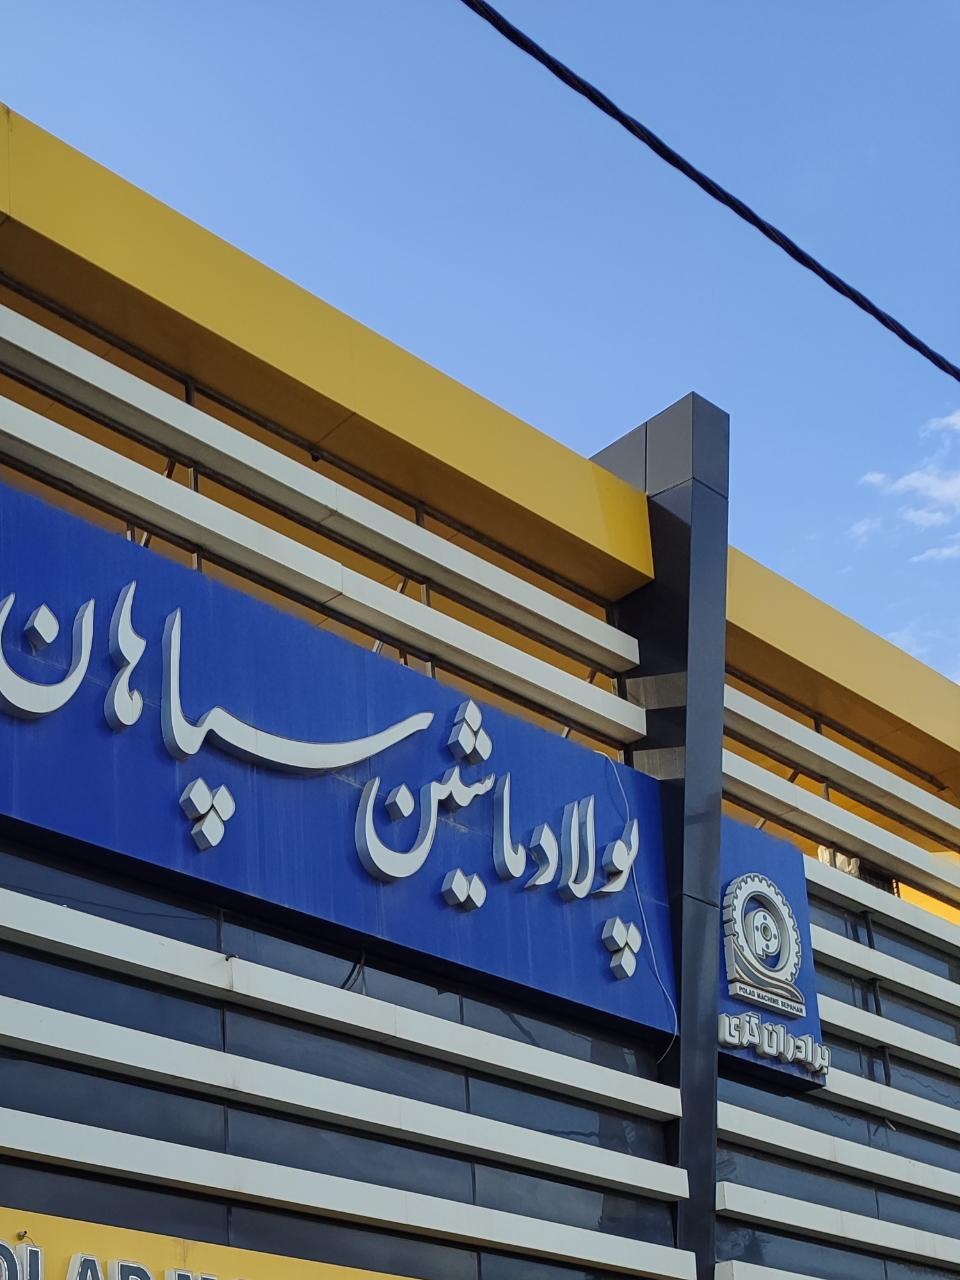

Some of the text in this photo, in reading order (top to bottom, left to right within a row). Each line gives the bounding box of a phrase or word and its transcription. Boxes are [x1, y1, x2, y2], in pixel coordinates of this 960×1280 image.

[354, 699, 527, 911] ماشین
[524, 793, 642, 980] پولاد
[738, 985, 804, 1014] POLAD MACHINE SEPAHAN
